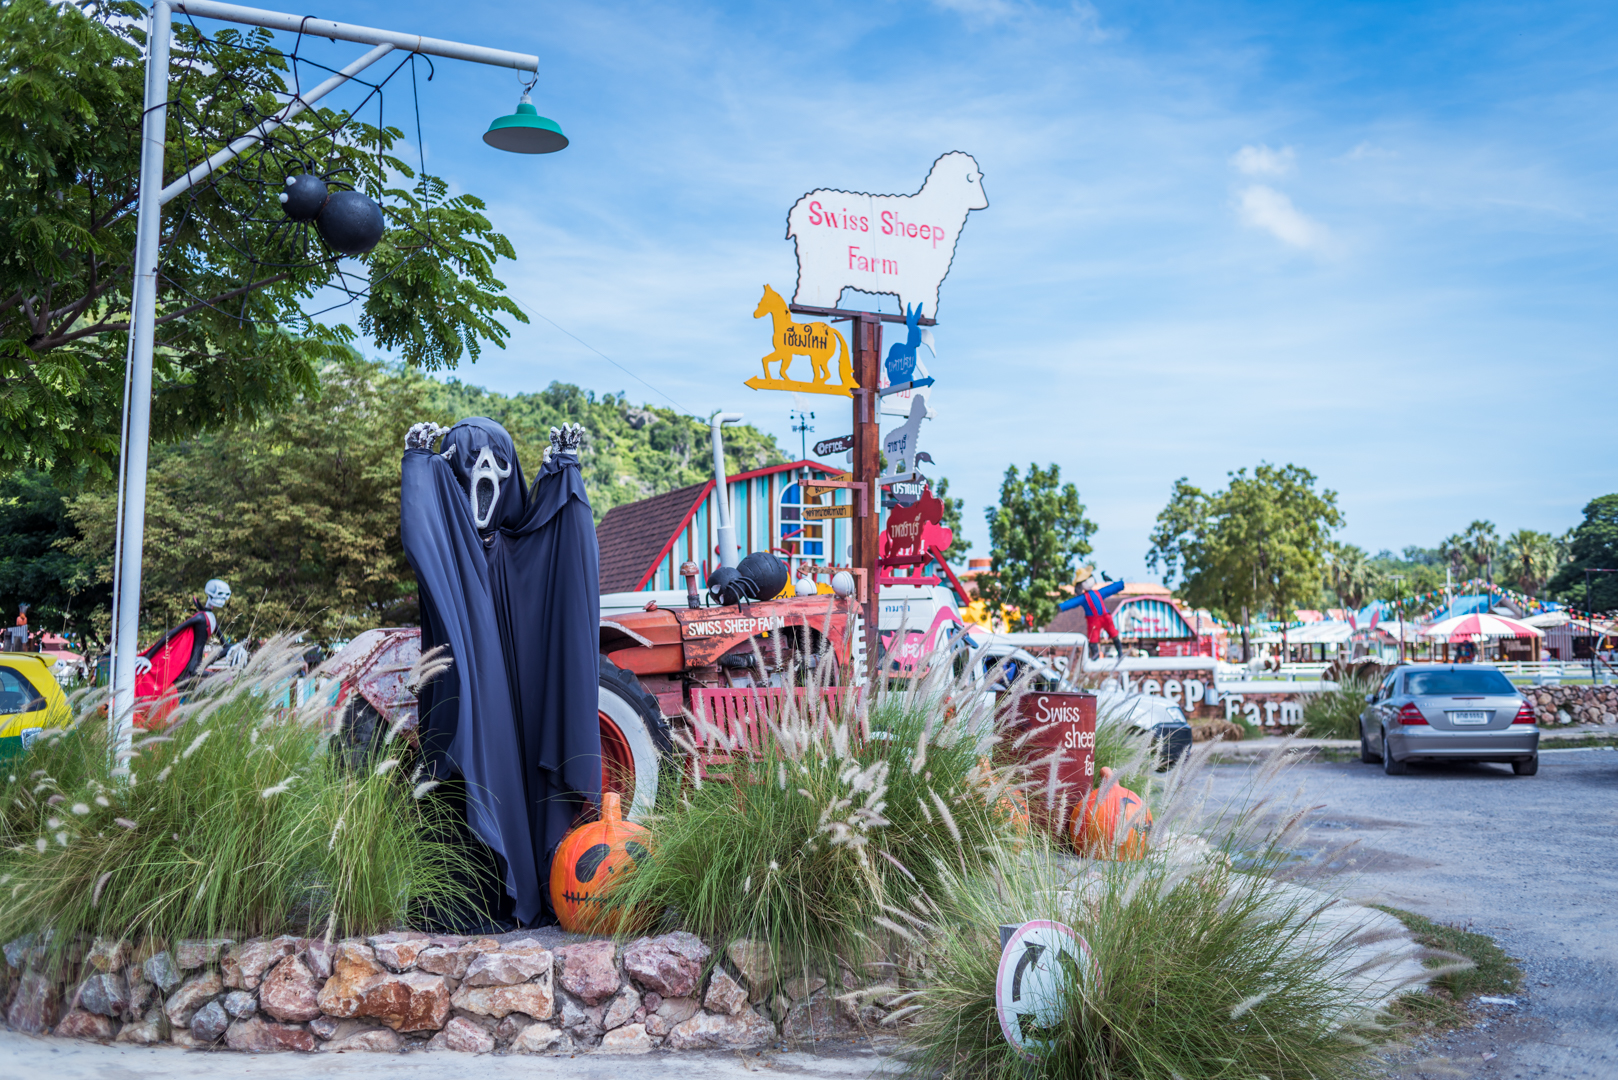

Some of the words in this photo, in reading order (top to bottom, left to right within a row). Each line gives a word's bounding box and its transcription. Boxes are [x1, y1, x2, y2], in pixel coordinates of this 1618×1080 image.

[808, 201, 869, 232] Swiss
[880, 210, 945, 249] Sheep
[848, 245, 899, 276] Farm
[816, 440, 844, 455] OFFICE
[890, 513, 921, 541] เพชรบุรี
[688, 620, 722, 637] SWISS
[724, 618, 757, 634] SHEEP
[1035, 696, 1080, 723] Swiss
[1225, 694, 1304, 727] Farm
